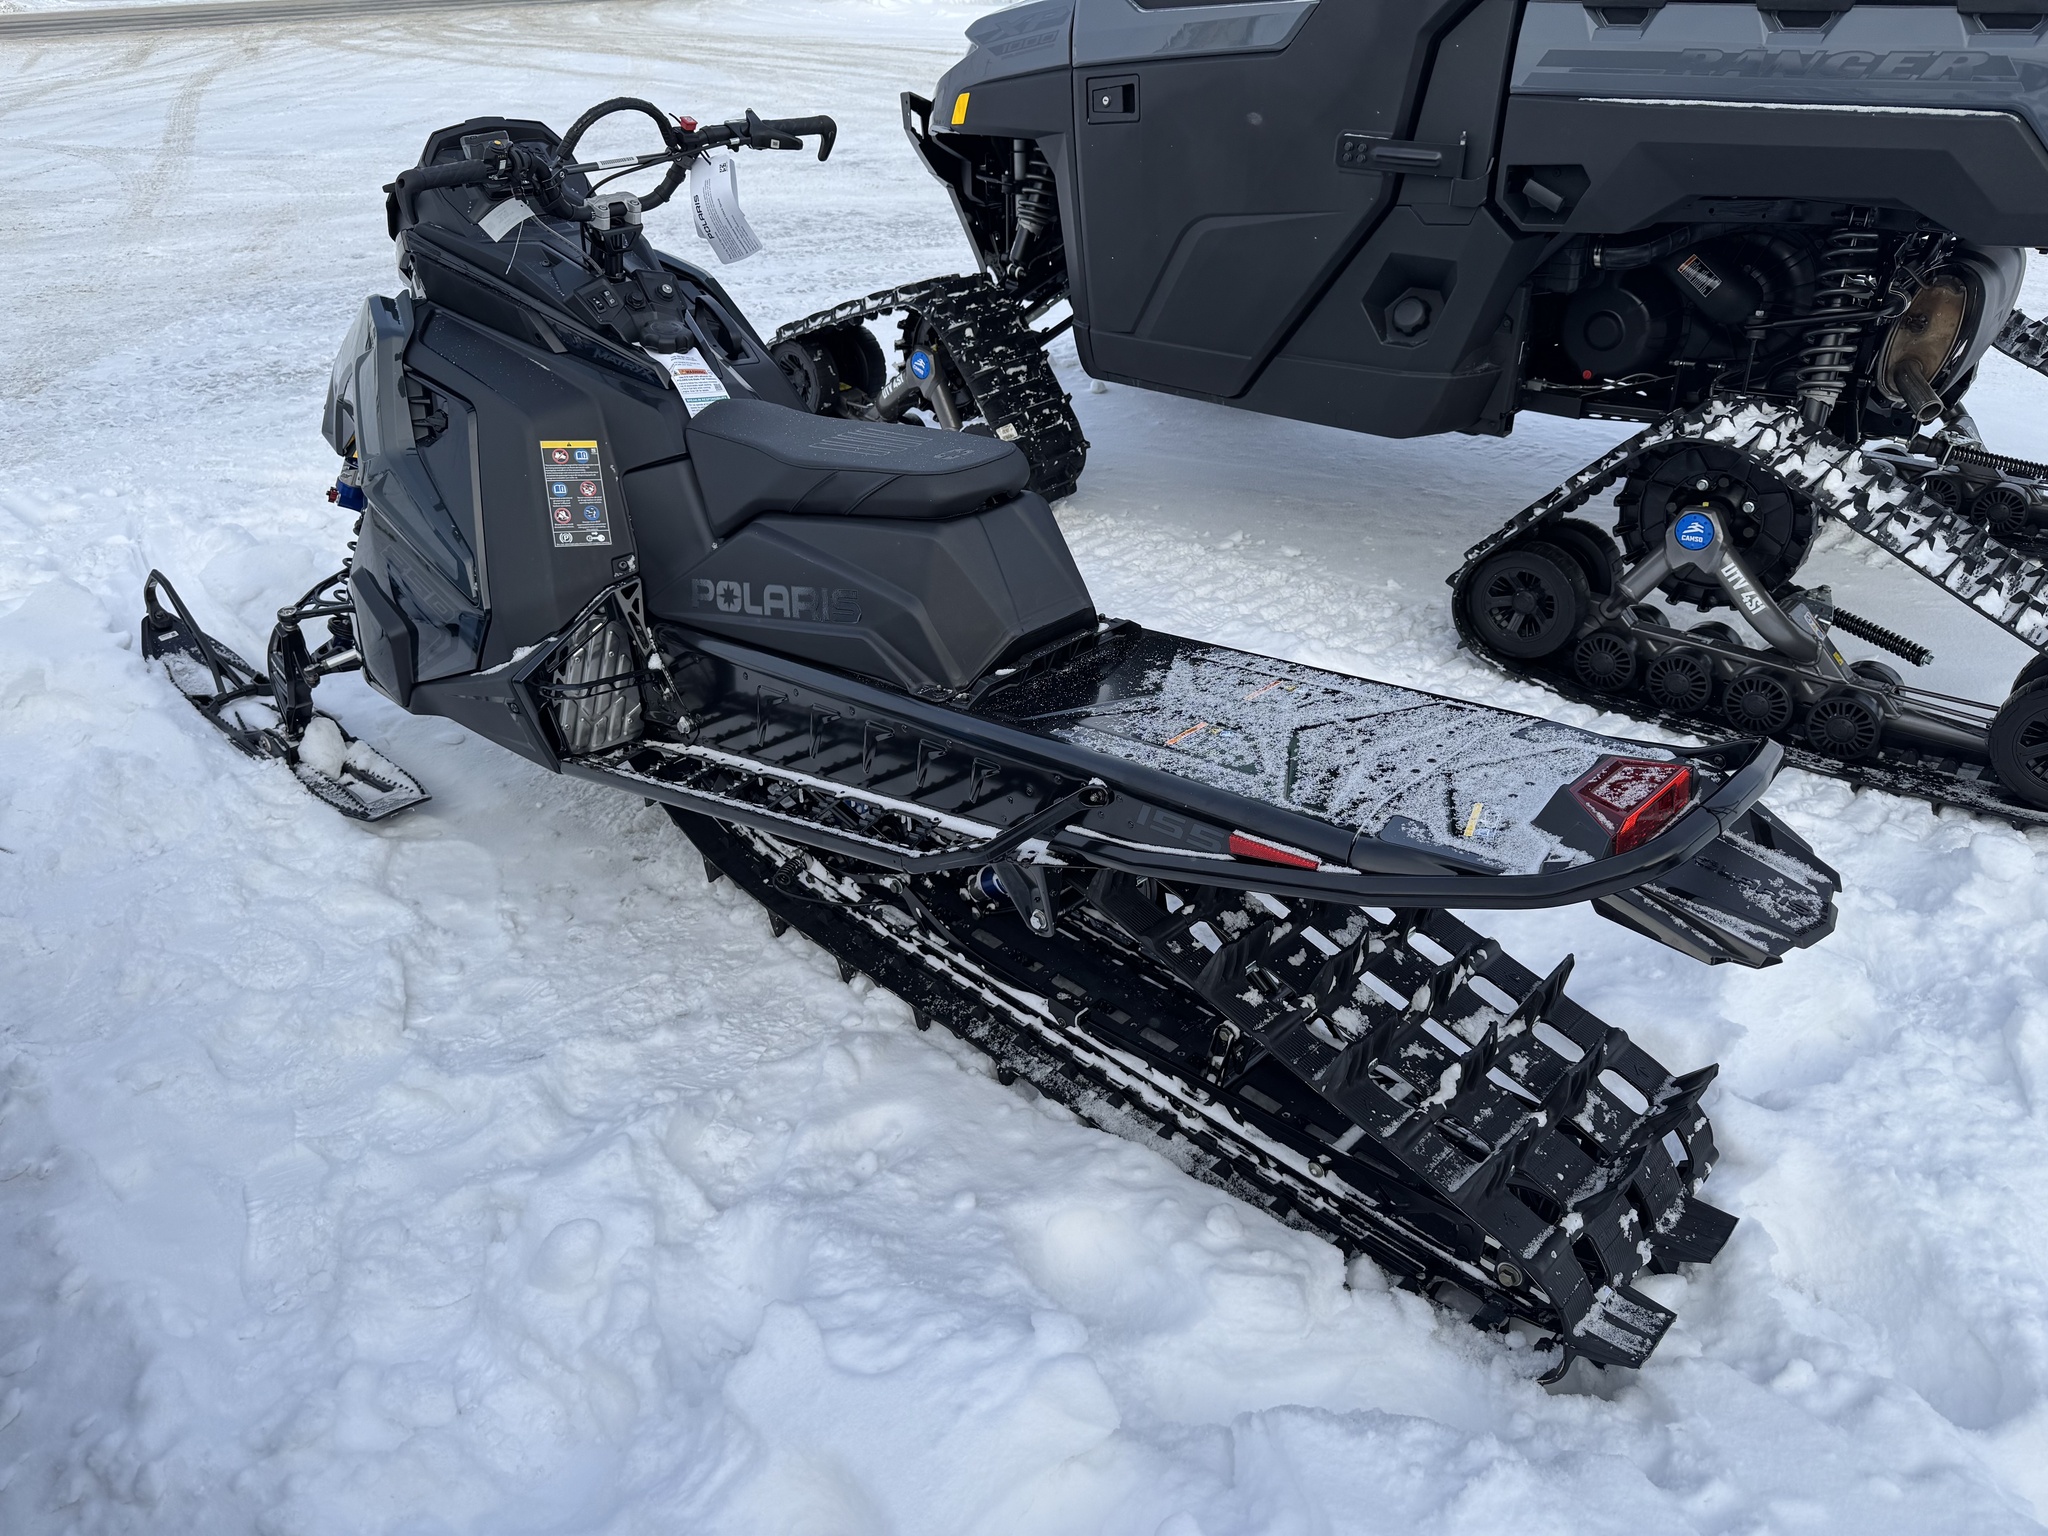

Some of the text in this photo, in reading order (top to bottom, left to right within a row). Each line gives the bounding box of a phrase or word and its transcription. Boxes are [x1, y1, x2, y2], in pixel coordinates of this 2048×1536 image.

[1002, 30, 1060, 54] 1000
[1665, 49, 1990, 81] RANGER
[693, 194, 715, 240] POLARIS
[593, 347, 656, 383] MATRYX
[1681, 534, 1704, 543] CAMSO
[1721, 562, 1750, 590] UTV
[691, 579, 862, 624] POLARIS
[1136, 804, 1225, 852] 155
